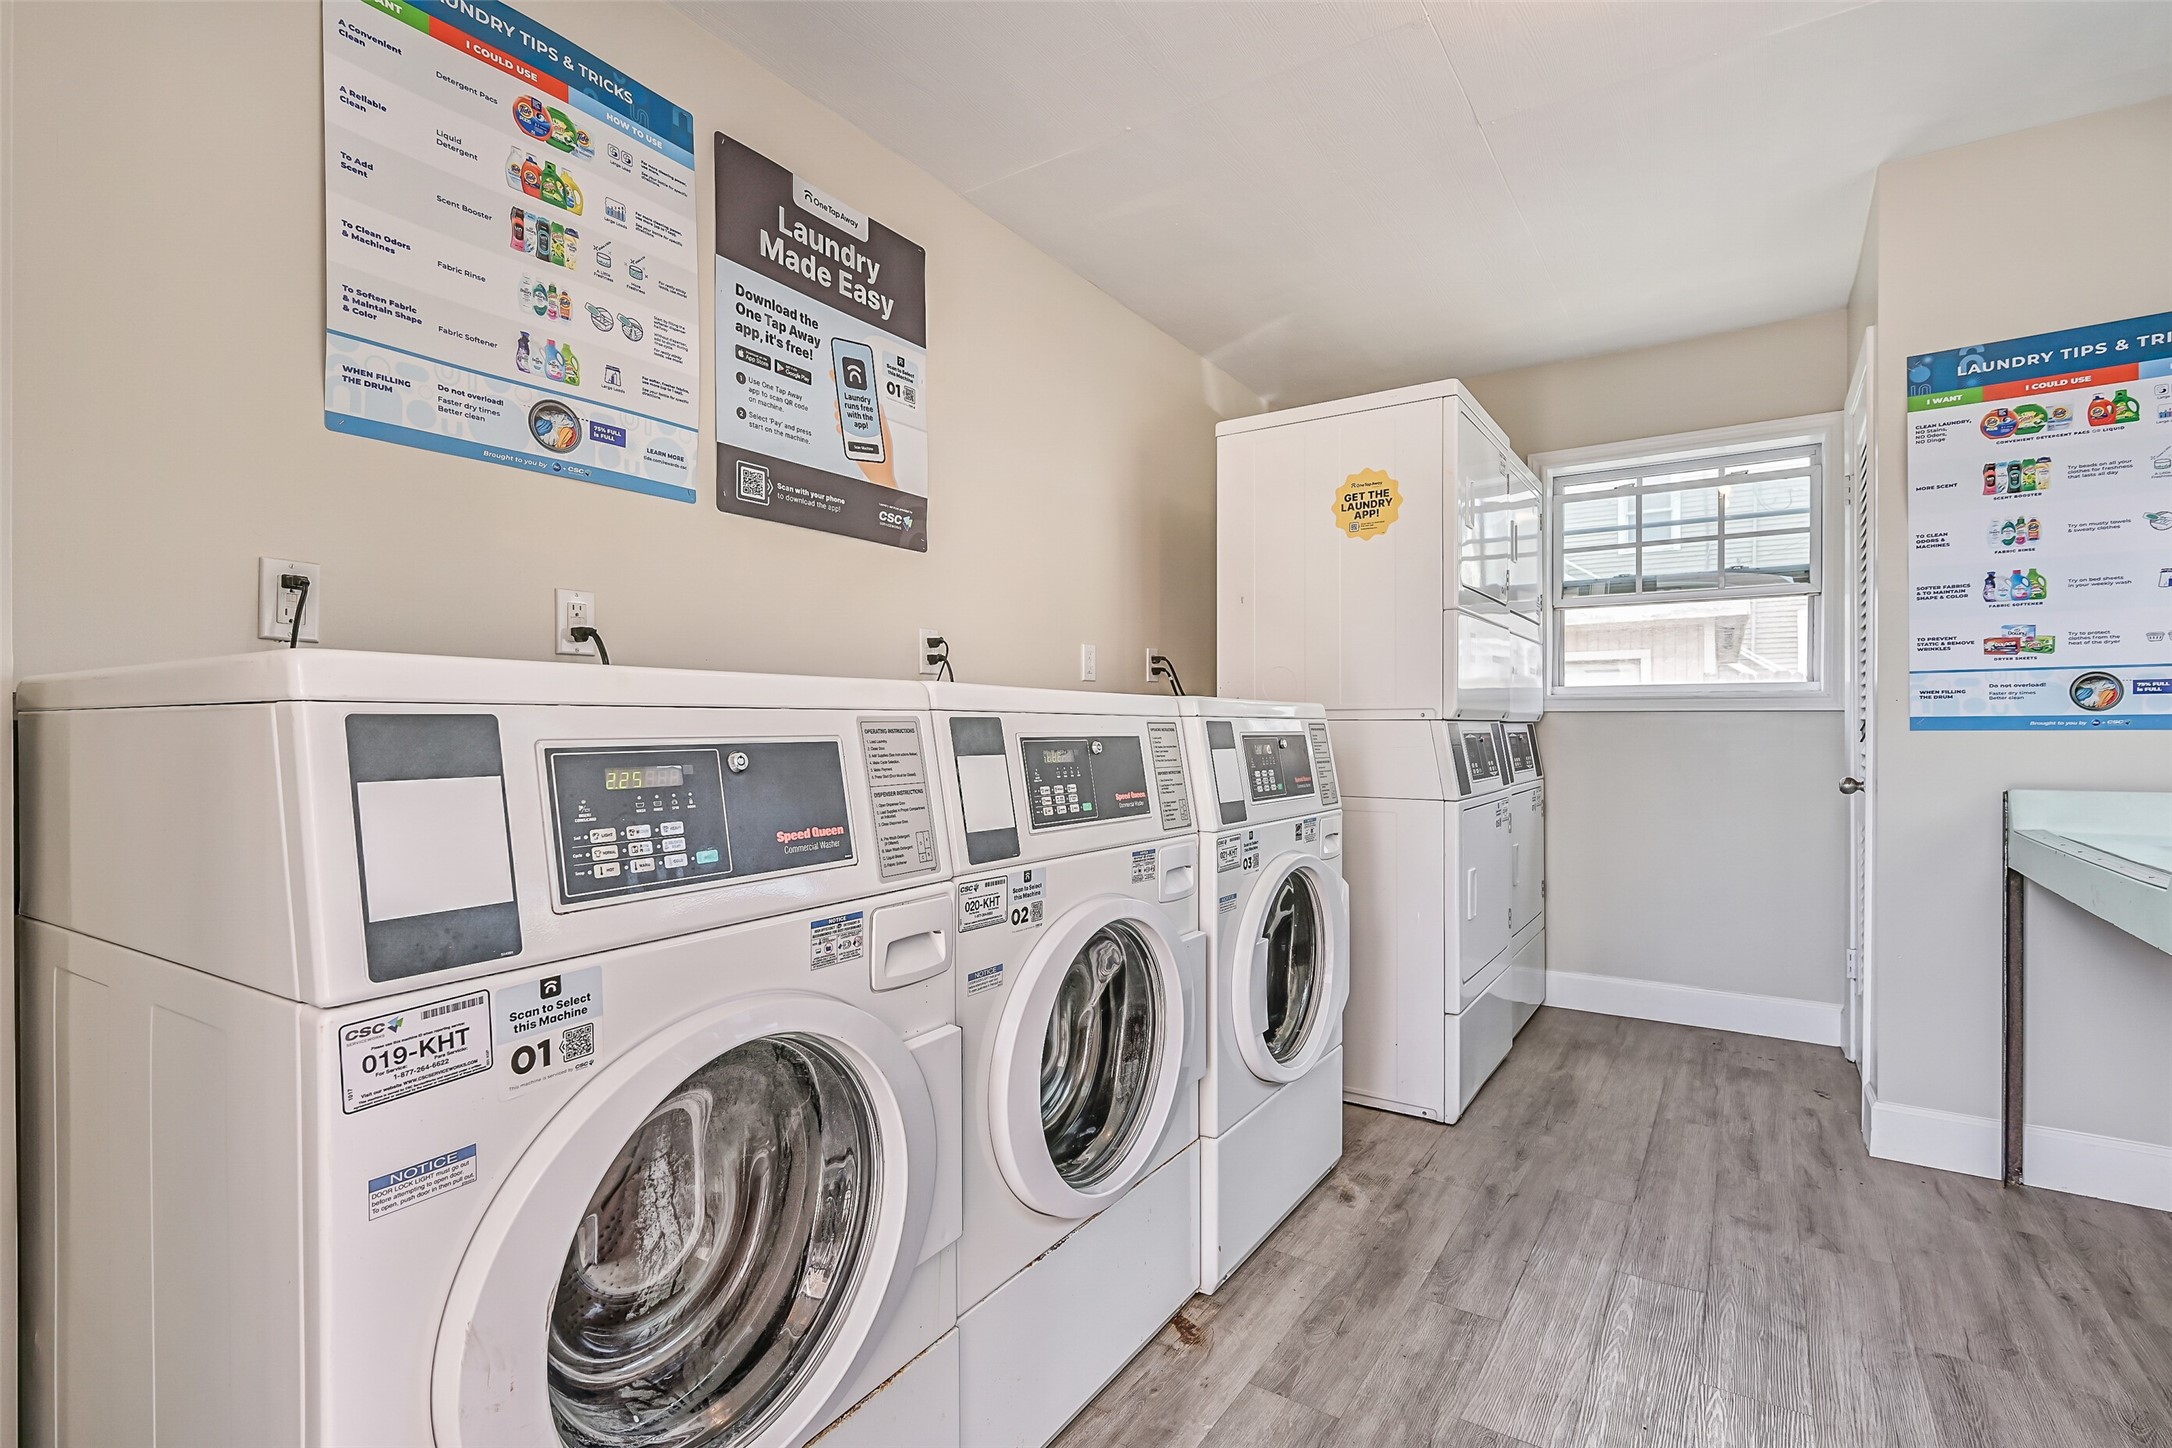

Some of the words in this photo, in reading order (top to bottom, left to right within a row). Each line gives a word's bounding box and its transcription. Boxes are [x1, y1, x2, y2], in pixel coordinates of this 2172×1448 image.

[338, 18, 346, 27] A
[348, 23, 402, 56] Convenient
[338, 28, 366, 47] Clean
[441, 0, 516, 38] UNDRY
[520, 30, 559, 62] TIPS
[563, 56, 575, 71] &
[578, 62, 633, 105] TRICKS
[466, 40, 470, 49] I
[473, 44, 514, 69] COULD
[516, 65, 538, 82] USE
[339, 85, 347, 94] A
[349, 89, 387, 112] Reliable
[436, 71, 478, 96] Detergent
[479, 90, 498, 105] Pacs
[339, 95, 367, 112] Clean
[436, 128, 462, 145] Liquid
[606, 112, 630, 130] HOW
[632, 126, 643, 138] TO
[645, 134, 663, 149] USE
[436, 138, 478, 161] Detergent
[340, 151, 352, 161] To
[354, 159, 374, 171] Add
[340, 161, 368, 178] Scent
[436, 195, 460, 209] Scent
[462, 204, 492, 221] Booster
[342, 219, 353, 229] To
[355, 226, 382, 240] Clean
[384, 235, 411, 251] Odors
[351, 233, 396, 254] Machines
[779, 205, 880, 285] Laundry
[437, 260, 462, 275] Fabric
[464, 270, 486, 282] Rinse
[760, 228, 832, 288] Made
[839, 269, 895, 321] Easy
[342, 284, 354, 294] To
[356, 289, 387, 304] Soften
[389, 299, 417, 314] Fabric
[735, 282, 797, 321] Download
[799, 312, 819, 330] the
[352, 298, 393, 316] Maintain
[395, 310, 423, 325] Shape
[352, 307, 378, 320] Color
[735, 302, 762, 323] One
[764, 313, 787, 335] Tap
[789, 325, 821, 349] Away
[438, 326, 463, 339] Fabric
[465, 334, 498, 349] Softener
[735, 321, 763, 343] app,
[765, 330, 784, 349] it's
[786, 340, 813, 361] free!
[1957, 351, 2054, 377] LAUNDRY
[2060, 342, 2108, 360] TIPS
[2114, 339, 2129, 351] &
[2136, 331, 2172, 347] TRI
[342, 365, 374, 379] WHEN
[376, 372, 411, 388] FILLING
[342, 375, 361, 386] THE
[364, 380, 393, 393] DRUM
[2025, 383, 2030, 391] I
[2032, 378, 2068, 390] COULD
[2070, 375, 2092, 385] USE
[438, 384, 450, 393] Do
[451, 388, 465, 397] not
[467, 393, 504, 407] overload!
[844, 392, 871, 405] Laundry
[886, 381, 901, 398] 01
[1932, 394, 1963, 404] WANT
[438, 396, 462, 408] Faster
[464, 401, 477, 412] dry
[478, 405, 501, 417] times
[438, 405, 463, 416] Better
[464, 411, 486, 422] clean
[1915, 422, 1937, 430] CLEAN
[1938, 419, 1972, 427] LAUNDRY,
[483, 449, 513, 462] Brought
[776, 482, 794, 493] Scan
[810, 491, 825, 501] your
[825, 494, 846, 505] phone
[1344, 491, 1366, 503] GET
[1367, 488, 1390, 499] THE
[1341, 497, 1393, 512] LAUNDRY
[1354, 509, 1380, 520] APP!
[879, 510, 903, 525] CSC
[1915, 542, 1951, 550] MACHINES
[605, 771, 642, 790] 2.25
[776, 828, 811, 844] Speed
[811, 826, 845, 837] Queen
[784, 842, 819, 855] Commercial
[820, 840, 840, 850] Washer
[1243, 856, 1252, 870] 03
[960, 885, 974, 893] CSC
[1022, 890, 1041, 899] Machine
[964, 895, 1001, 913] 020-KHT
[1011, 906, 1029, 926] 02
[974, 966, 997, 979] NOTICE
[509, 1007, 540, 1022] Scan
[542, 1004, 554, 1014] to
[556, 993, 592, 1010] Select
[513, 1020, 537, 1034] this
[539, 1007, 588, 1027] Machine
[345, 1022, 386, 1042] CSC
[362, 1026, 470, 1074] 019-KHT
[511, 1038, 551, 1075] 01
[393, 1058, 450, 1080] 1-877-264-6622
[390, 1151, 458, 1185] NOTICE
[371, 1187, 393, 1200] DOOR
[394, 1180, 414, 1192] LOCK
[414, 1173, 435, 1185] LIGHT
[435, 1167, 450, 1177] must
[451, 1164, 459, 1172] go
[460, 1160, 470, 1168] out
[371, 1196, 392, 1208] before
[393, 1184, 426, 1201] attempting
[433, 1176, 449, 1186] open
[449, 1170, 464, 1179] door.
[380, 1201, 399, 1212] open,
[400, 1195, 416, 1206] push
[416, 1188, 431, 1199] door
[438, 1181, 452, 1191] then
[452, 1176, 464, 1187] pull
